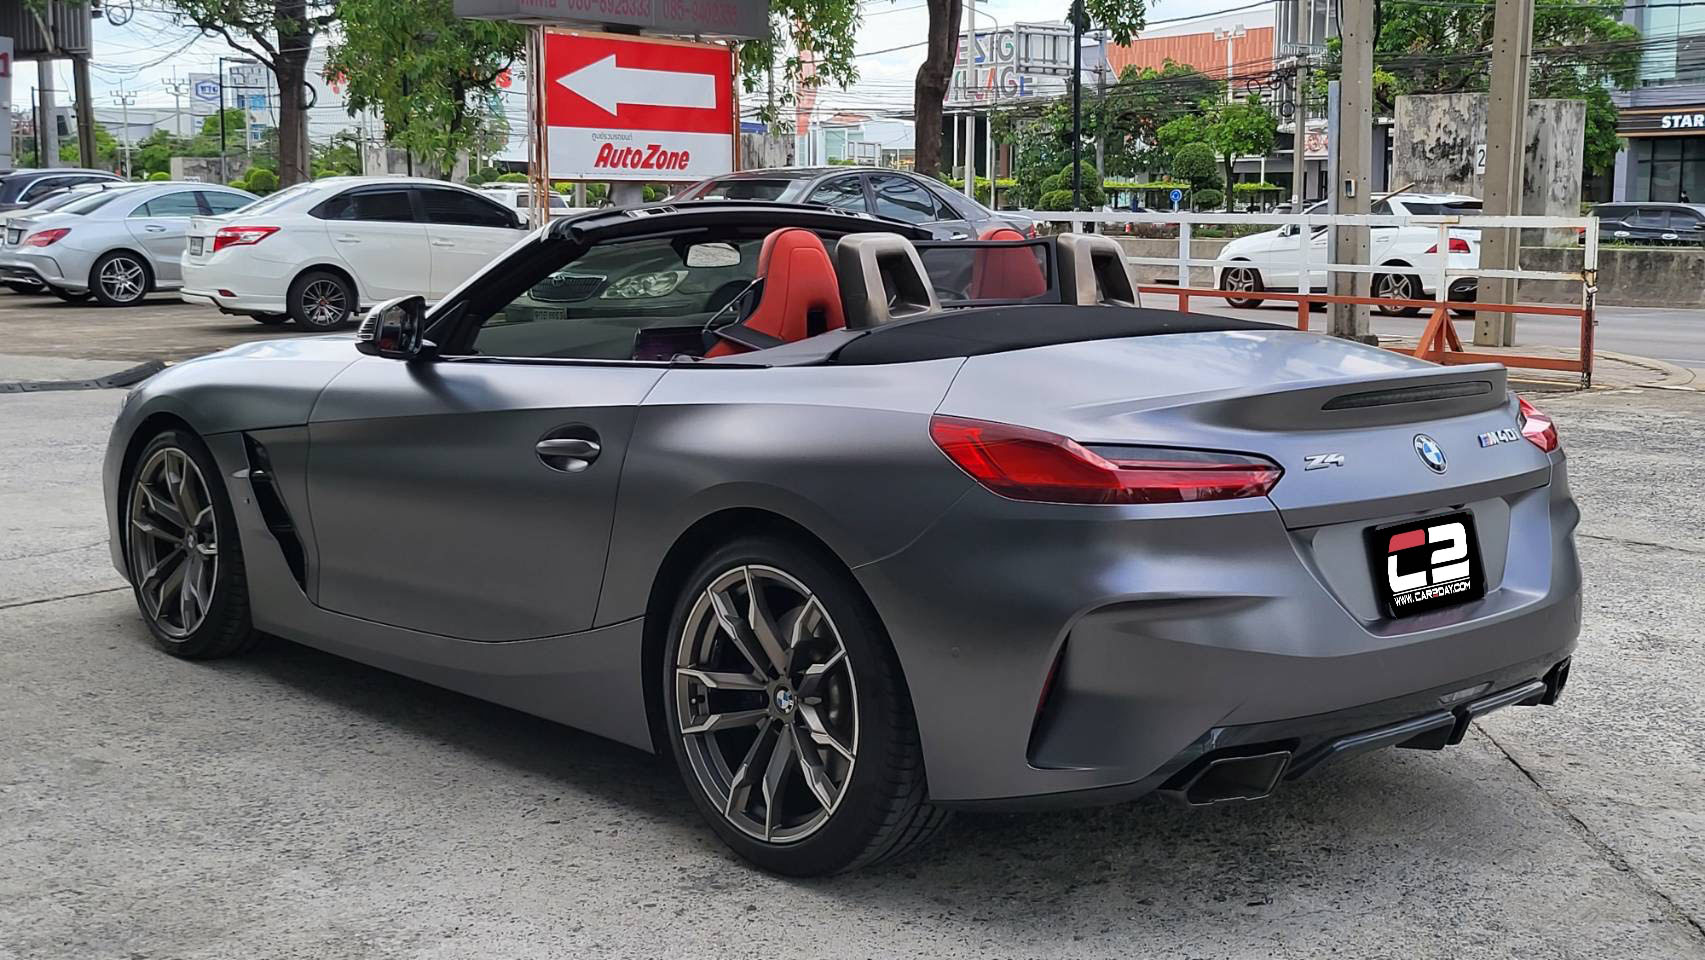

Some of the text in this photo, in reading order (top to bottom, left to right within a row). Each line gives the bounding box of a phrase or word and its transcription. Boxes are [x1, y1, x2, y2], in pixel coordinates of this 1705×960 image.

[955, 33, 1015, 65] ESIG
[945, 66, 1033, 101] ILLAGE
[1661, 114, 1705, 129] STAR
[594, 143, 690, 170] AutoZone
[1304, 452, 1345, 471] Z4
